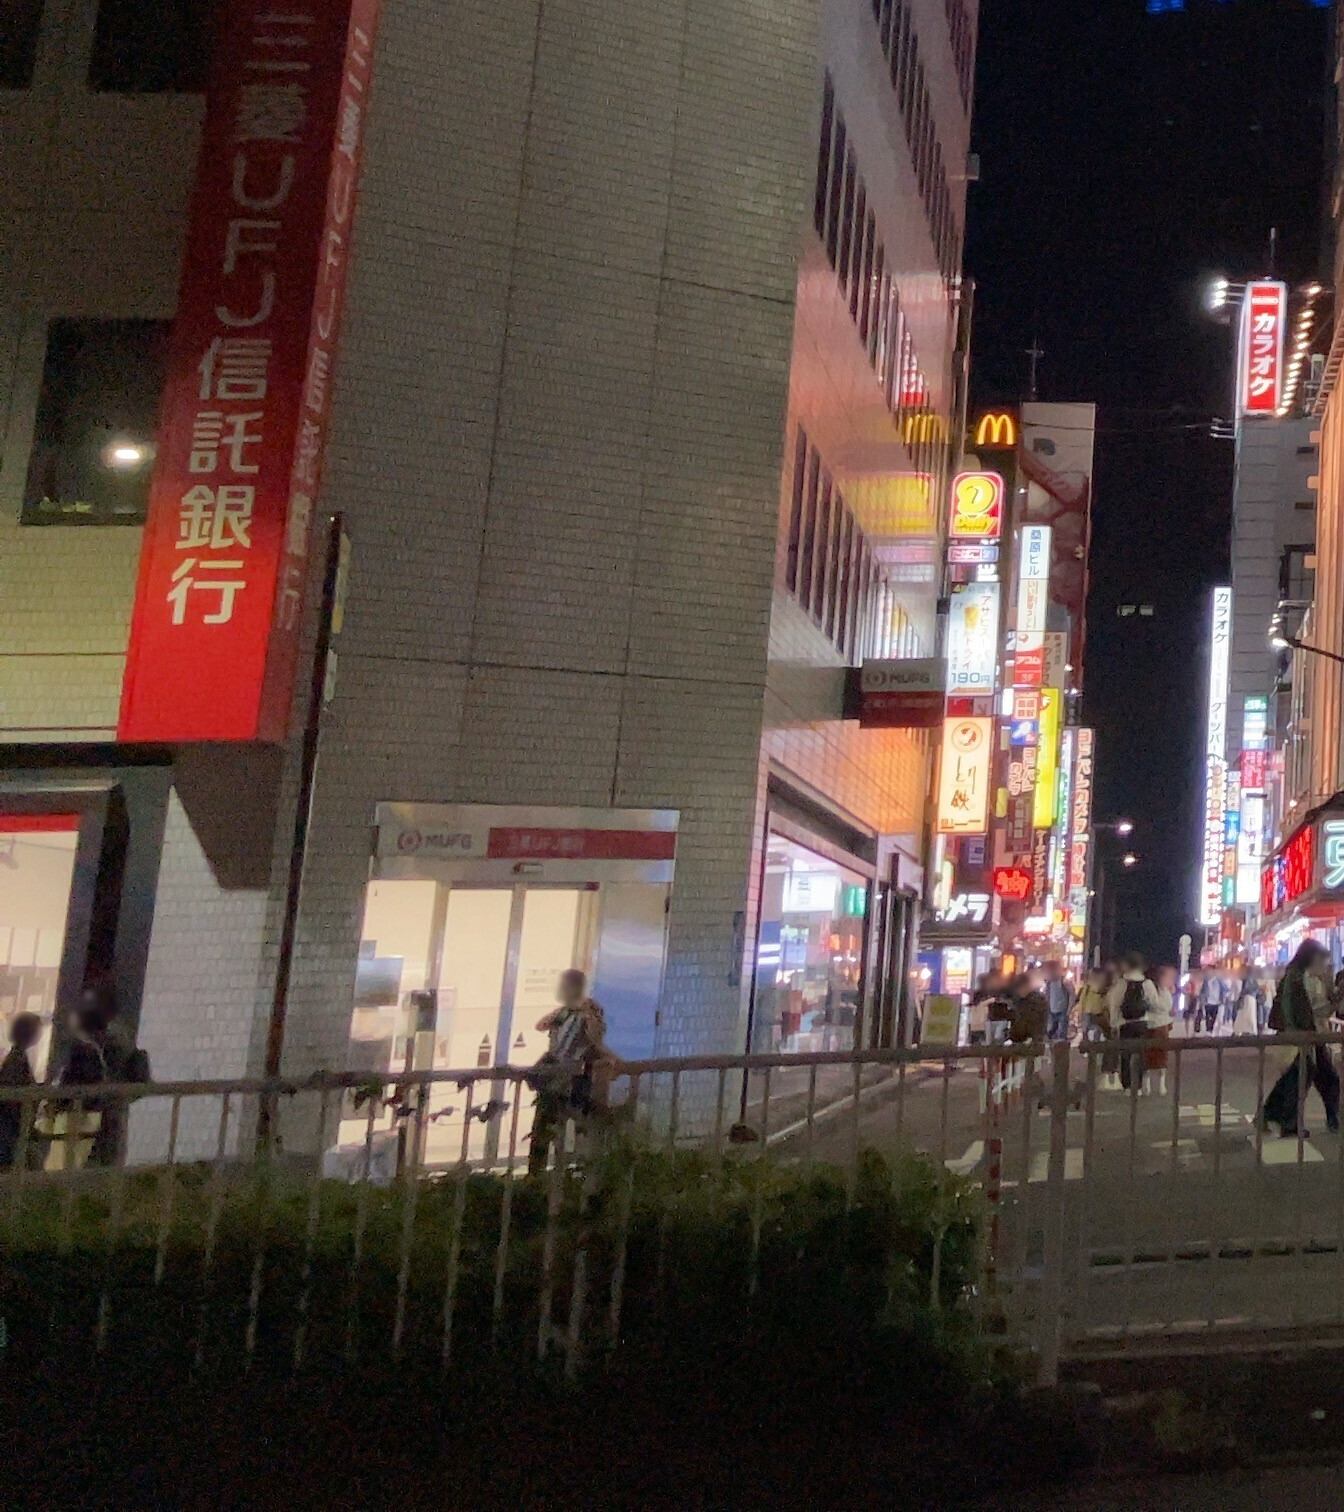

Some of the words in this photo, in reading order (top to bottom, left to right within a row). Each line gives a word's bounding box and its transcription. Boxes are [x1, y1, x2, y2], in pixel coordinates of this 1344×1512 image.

[1250, 312, 1276, 397] カラオケ
[1213, 593, 1229, 643] カラオケ
[936, 893, 990, 922] メラ
